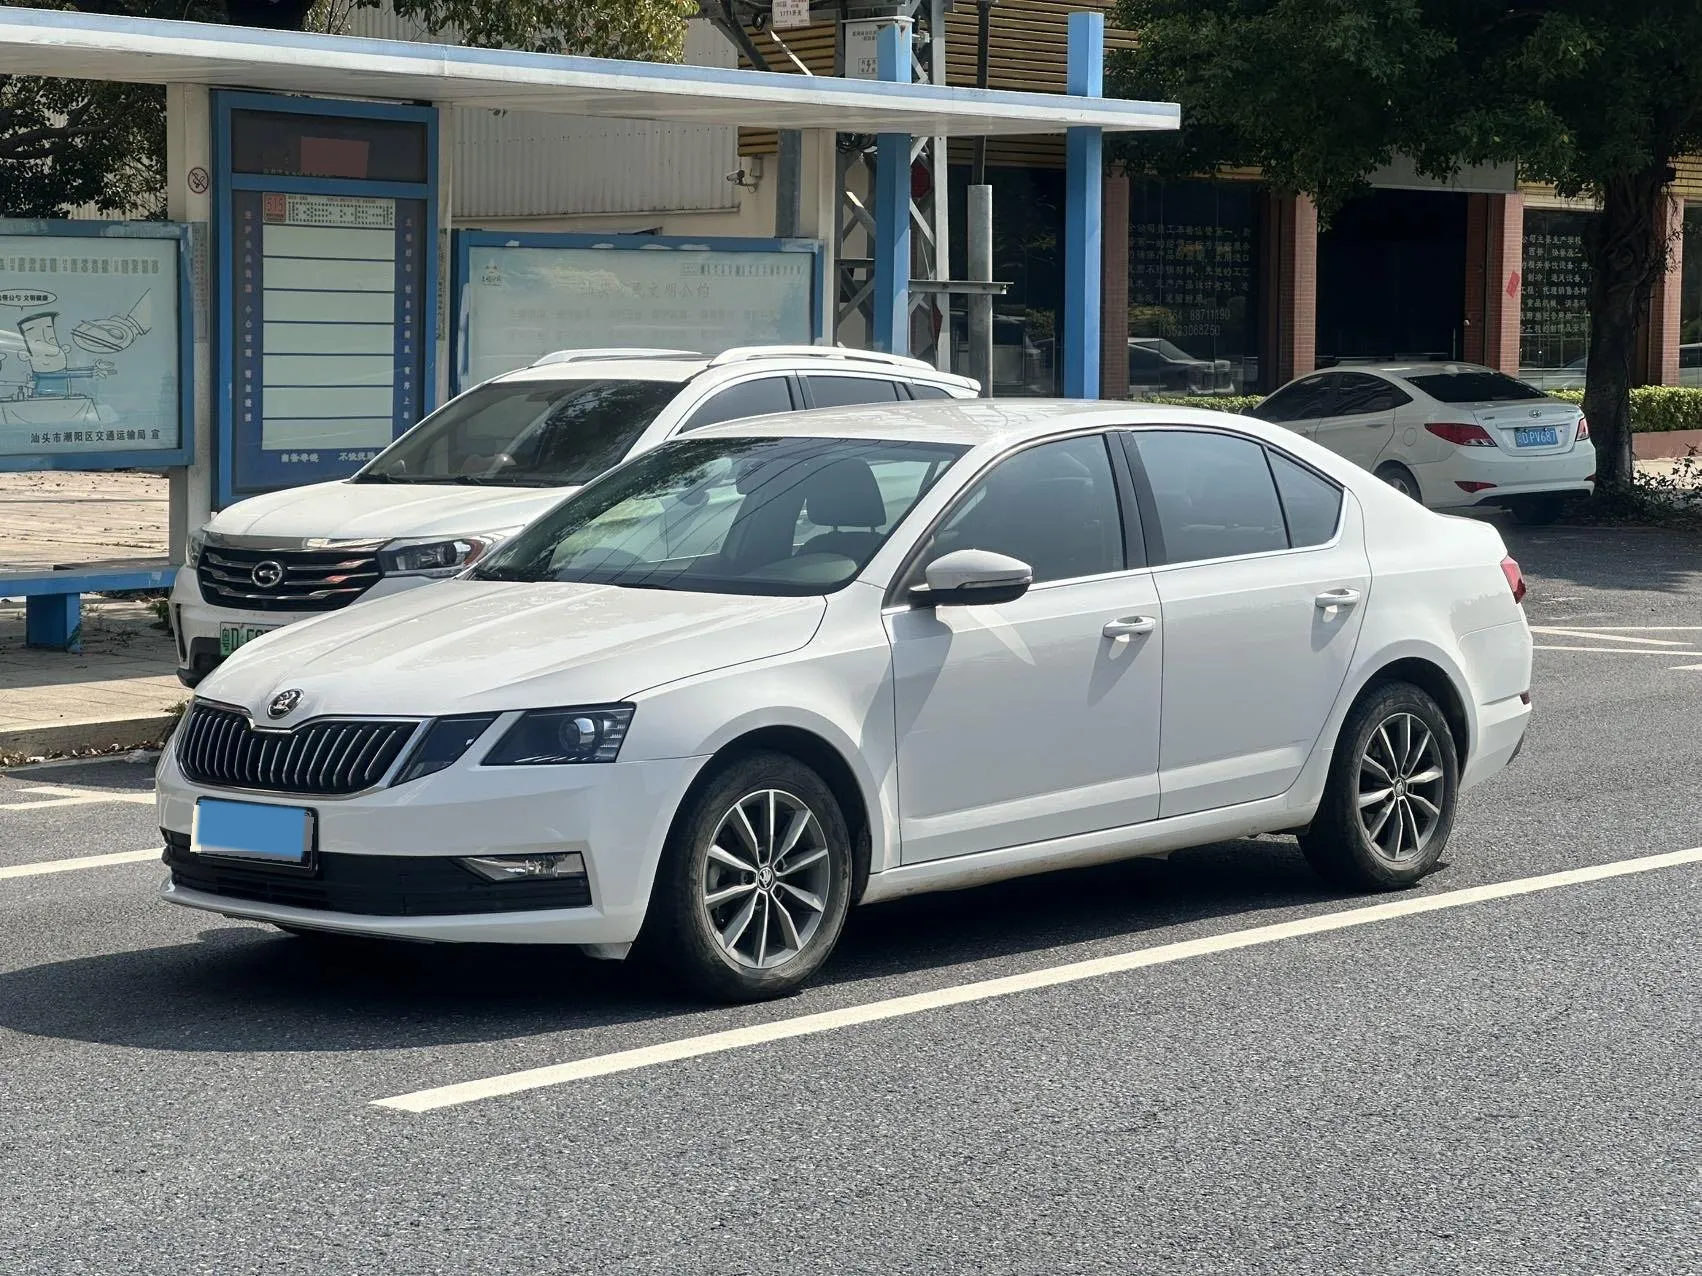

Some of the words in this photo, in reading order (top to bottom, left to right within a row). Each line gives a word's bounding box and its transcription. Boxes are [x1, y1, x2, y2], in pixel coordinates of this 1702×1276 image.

[30, 429, 146, 444] 汕头市潮阳区交通运输局
[150, 428, 161, 440] 宣
